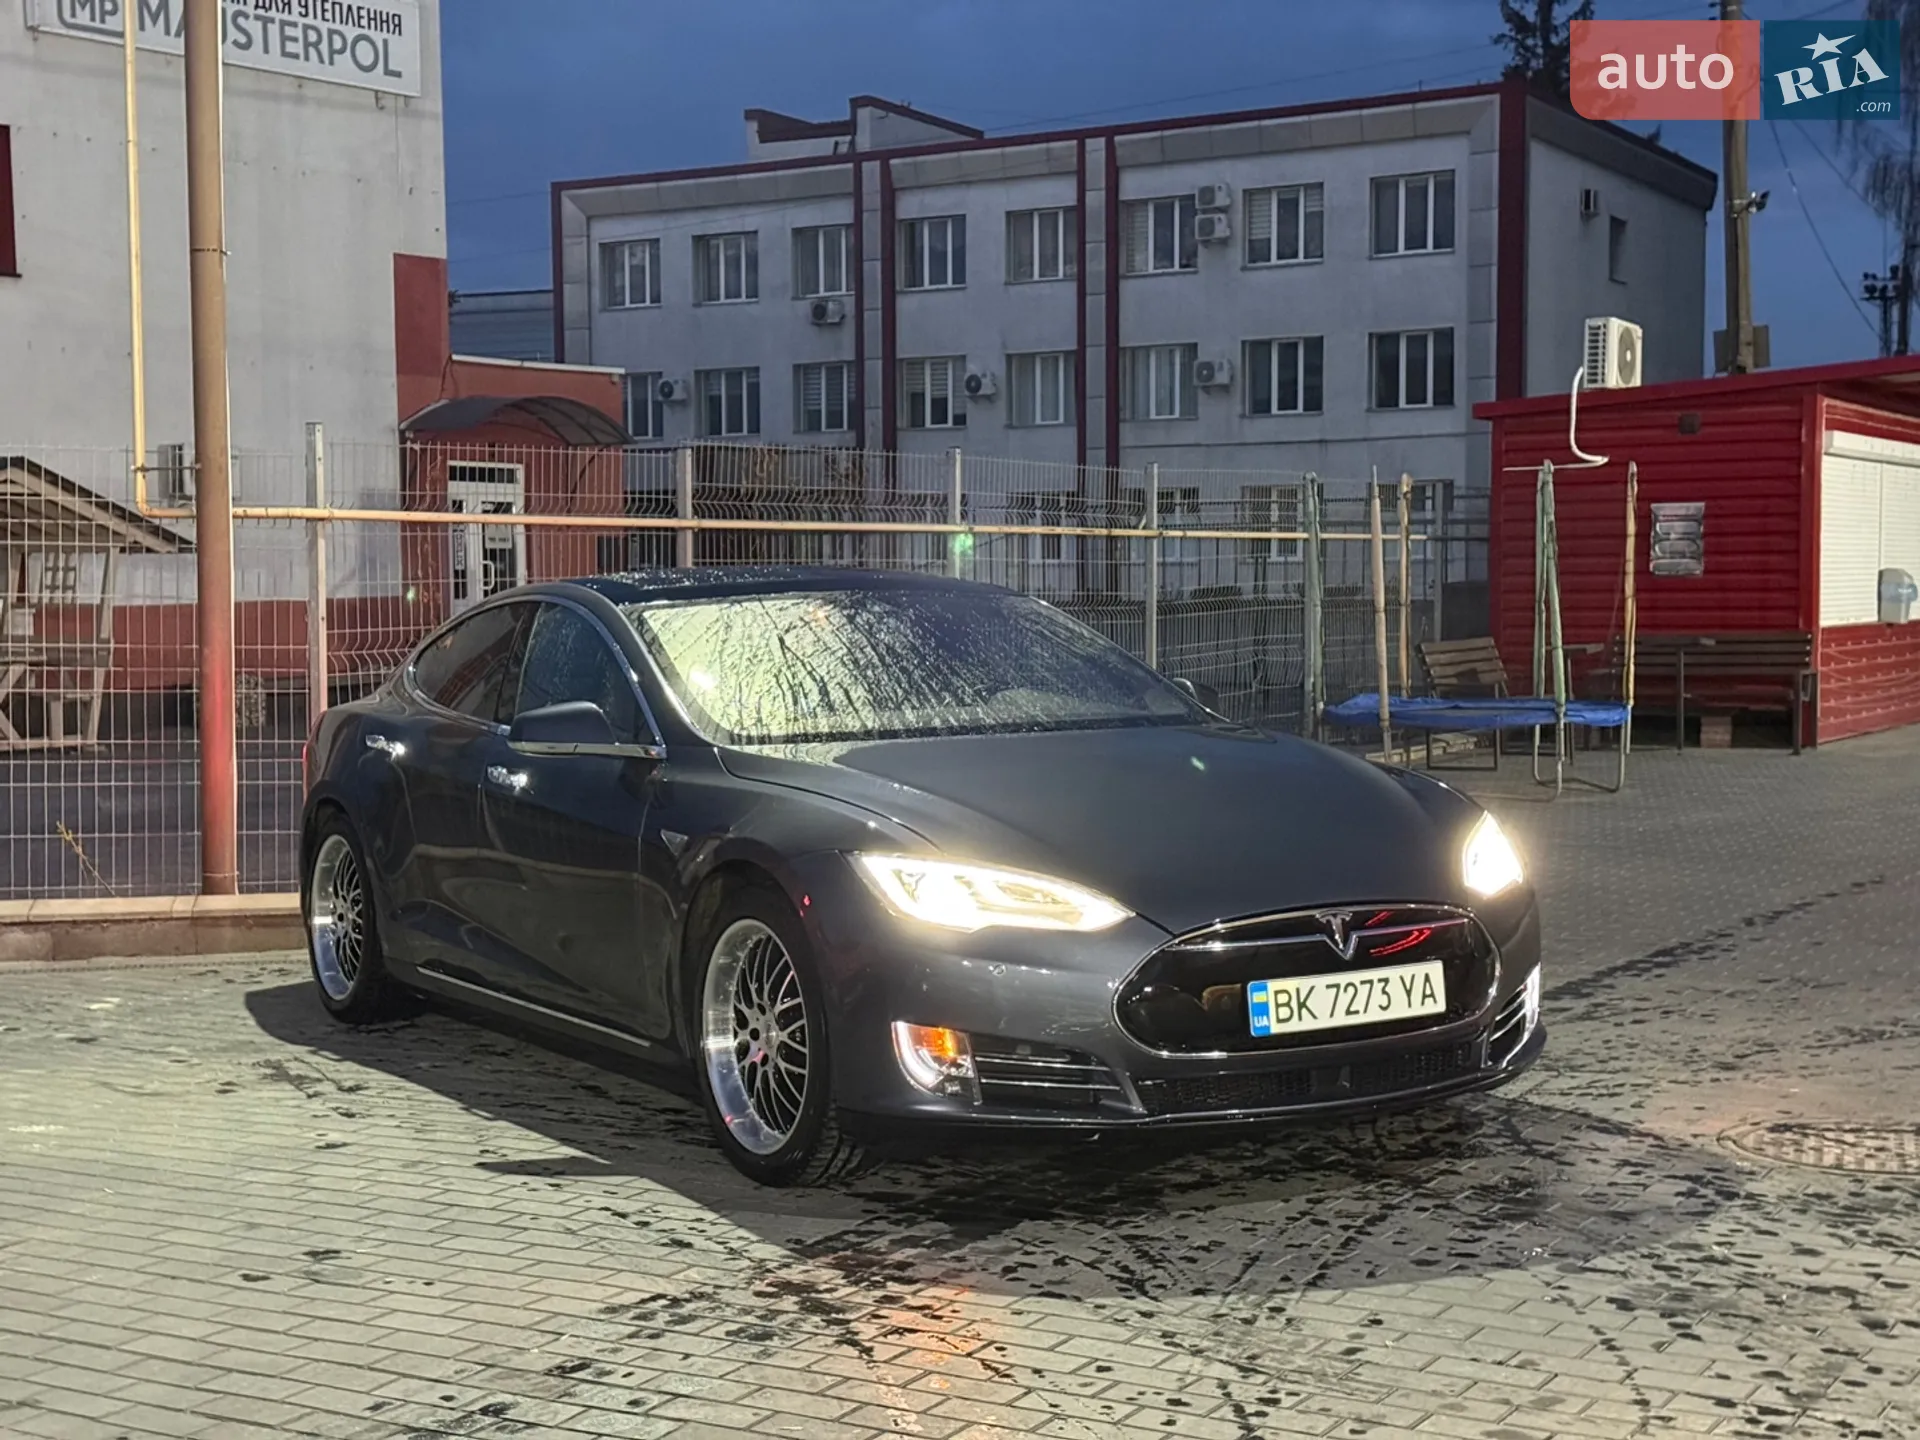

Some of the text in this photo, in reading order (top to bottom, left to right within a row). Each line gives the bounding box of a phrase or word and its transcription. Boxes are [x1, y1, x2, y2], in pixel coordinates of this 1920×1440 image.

[137, 0, 403, 78] MSTERPOL
[298, 0, 403, 36] УТЕПЛЕННЯ
[1273, 972, 1438, 1024] BK 7273 YA
[1254, 1015, 1270, 1028] UA
